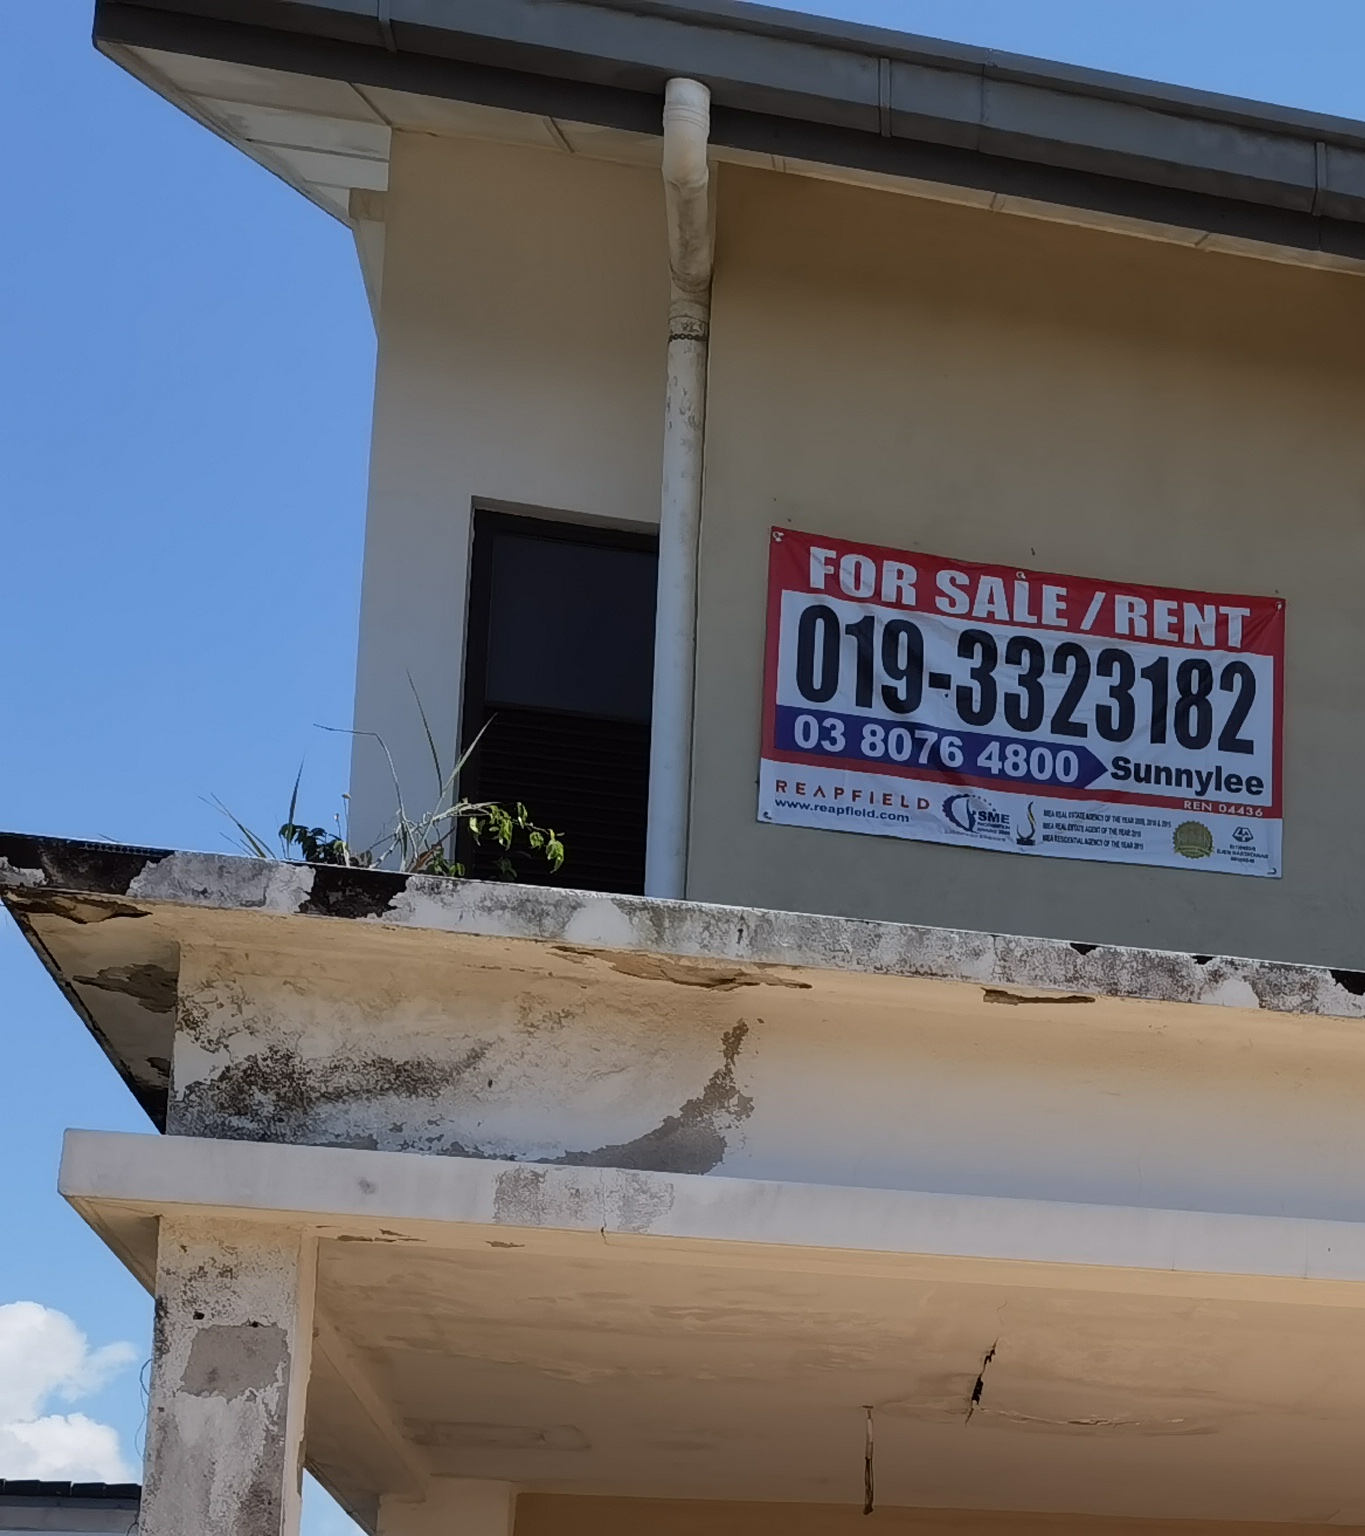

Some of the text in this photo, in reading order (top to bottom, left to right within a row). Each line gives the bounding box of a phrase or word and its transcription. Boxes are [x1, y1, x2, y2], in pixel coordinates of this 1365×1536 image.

[809, 546, 917, 606] FOR
[935, 569, 1069, 628] SALE
[1114, 594, 1251, 649] RENT
[795, 603, 1256, 755] 019-3323182
[793, 714, 1080, 784] 03 8076 4800
[1110, 755, 1265, 797] Sunnylee
[775, 779, 930, 810] REAPFIELD
[775, 798, 910, 824] www.reapfield.com
[1184, 800, 1263, 817] REN 04436
[977, 810, 1010, 824] SME
